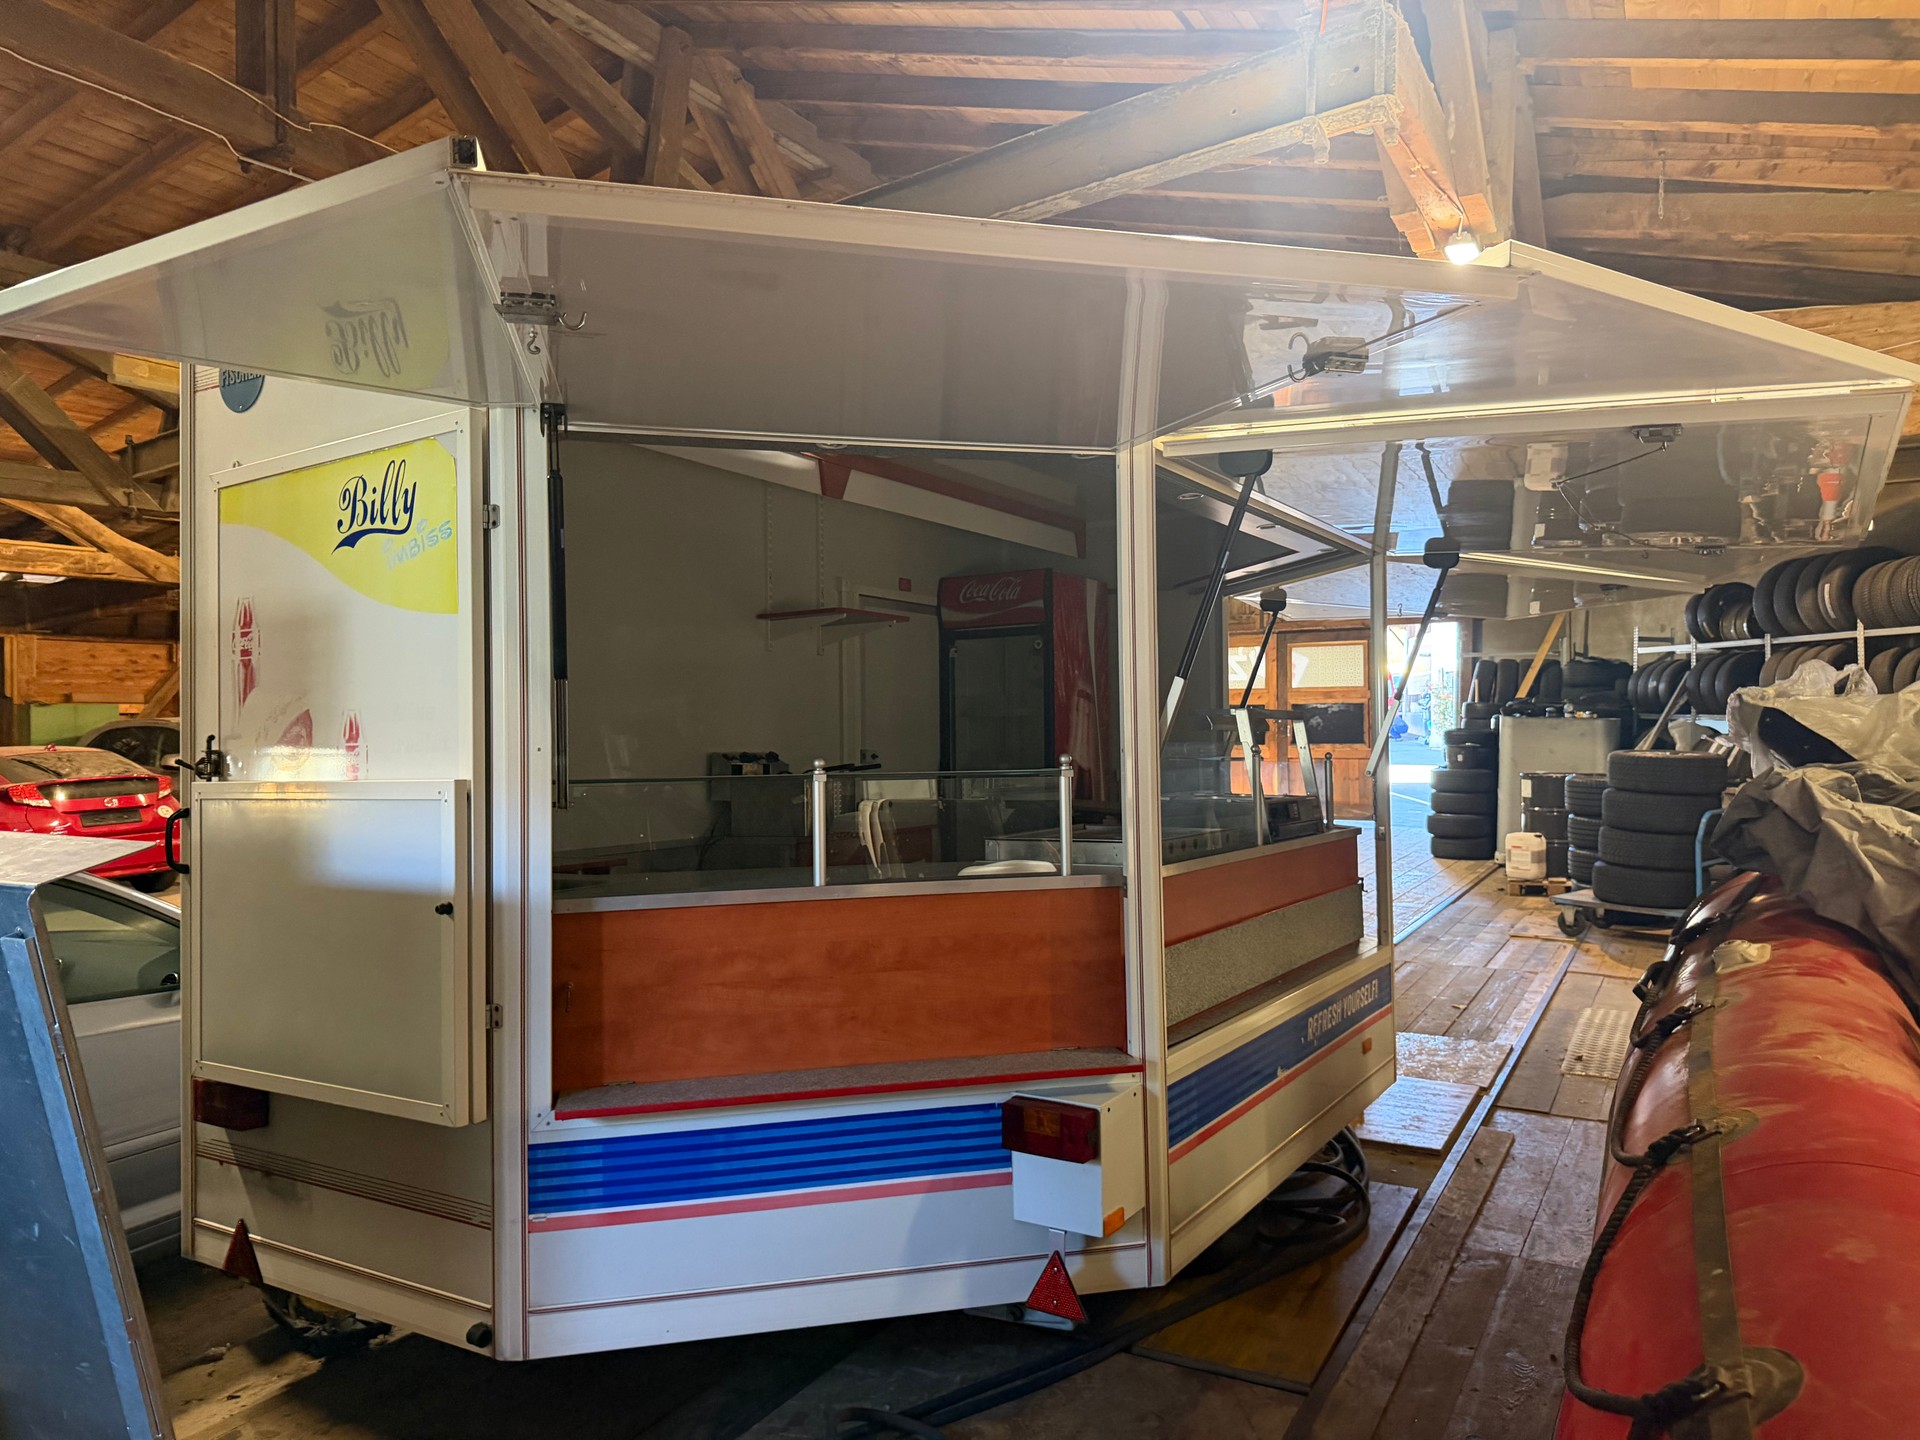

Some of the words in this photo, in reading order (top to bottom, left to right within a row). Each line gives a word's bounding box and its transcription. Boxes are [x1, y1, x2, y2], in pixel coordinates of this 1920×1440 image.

[331, 459, 417, 554] Billy
[1307, 1001, 1342, 1041] REFRESH
[1343, 979, 1378, 1018] YOURSELF!
